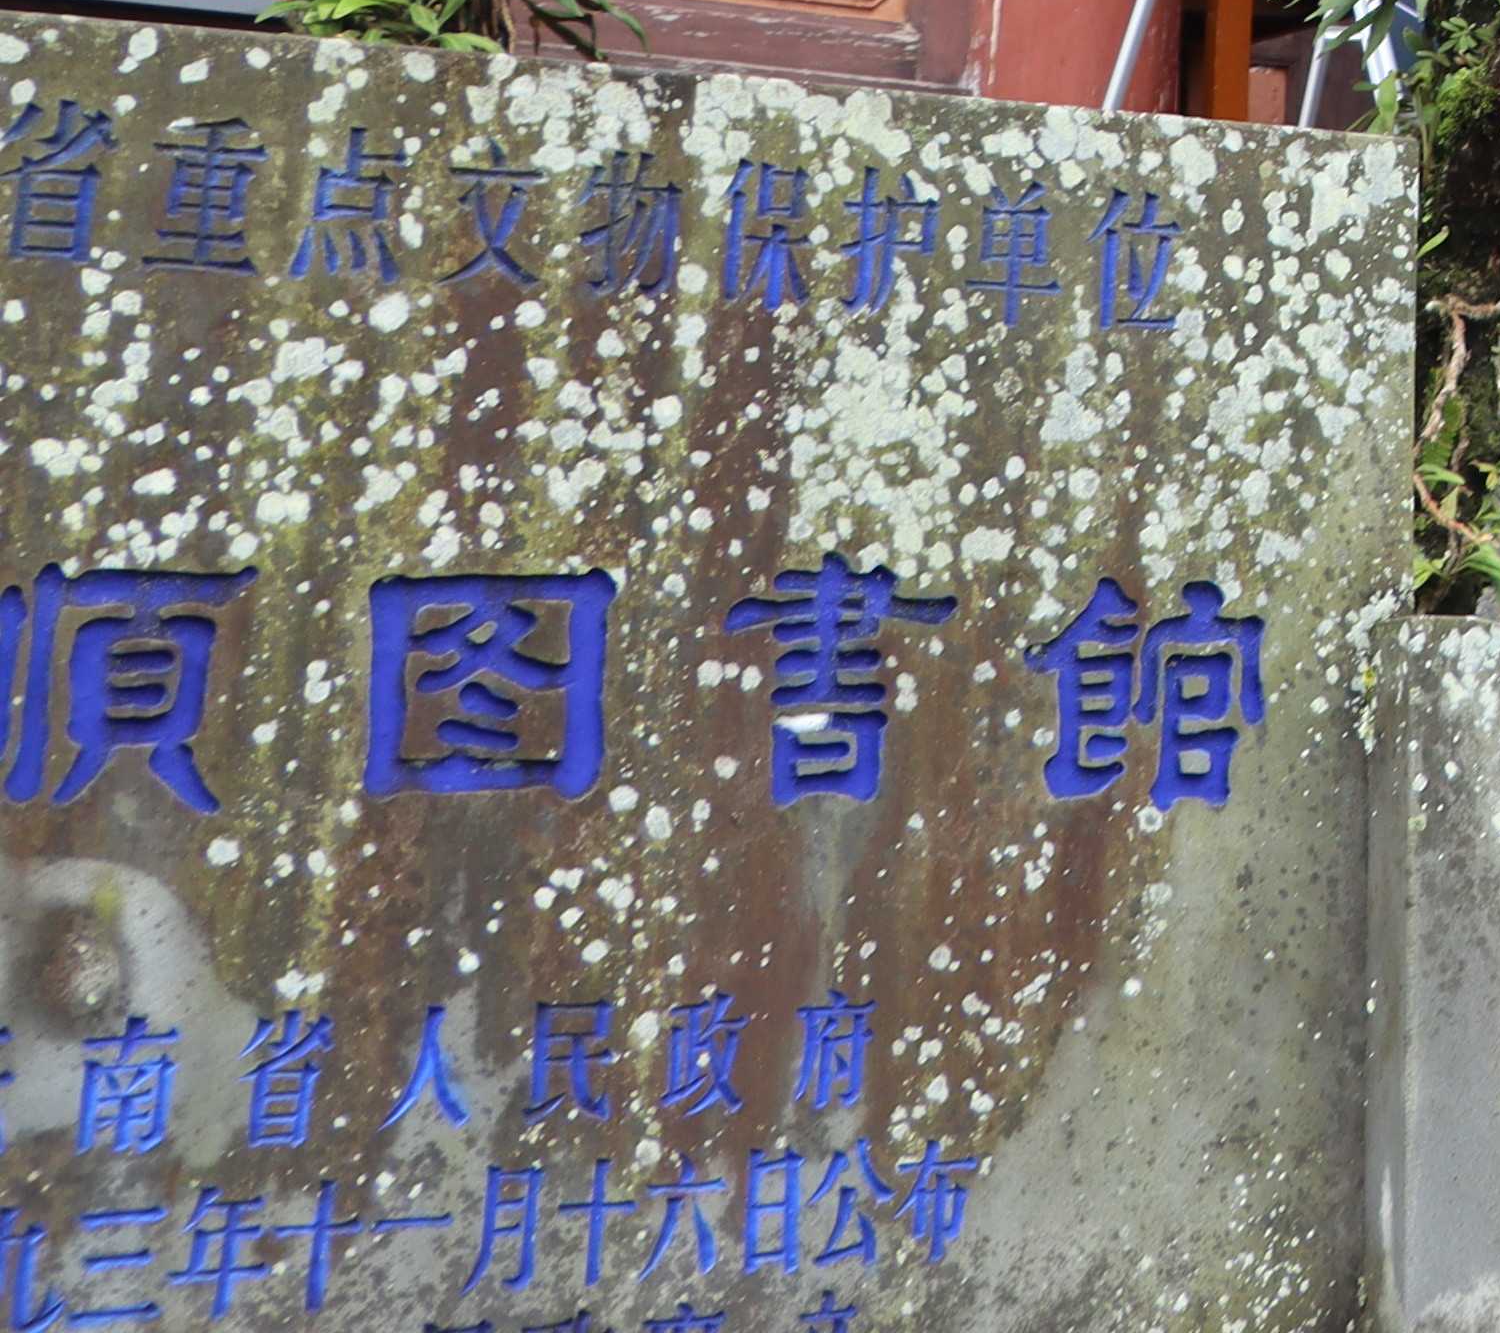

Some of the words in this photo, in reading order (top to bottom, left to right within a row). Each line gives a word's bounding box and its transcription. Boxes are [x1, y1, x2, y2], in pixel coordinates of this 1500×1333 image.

[0, 98, 1183, 331] 省重点文物保护单位
[0, 988, 876, 1156] 南省人民政府
